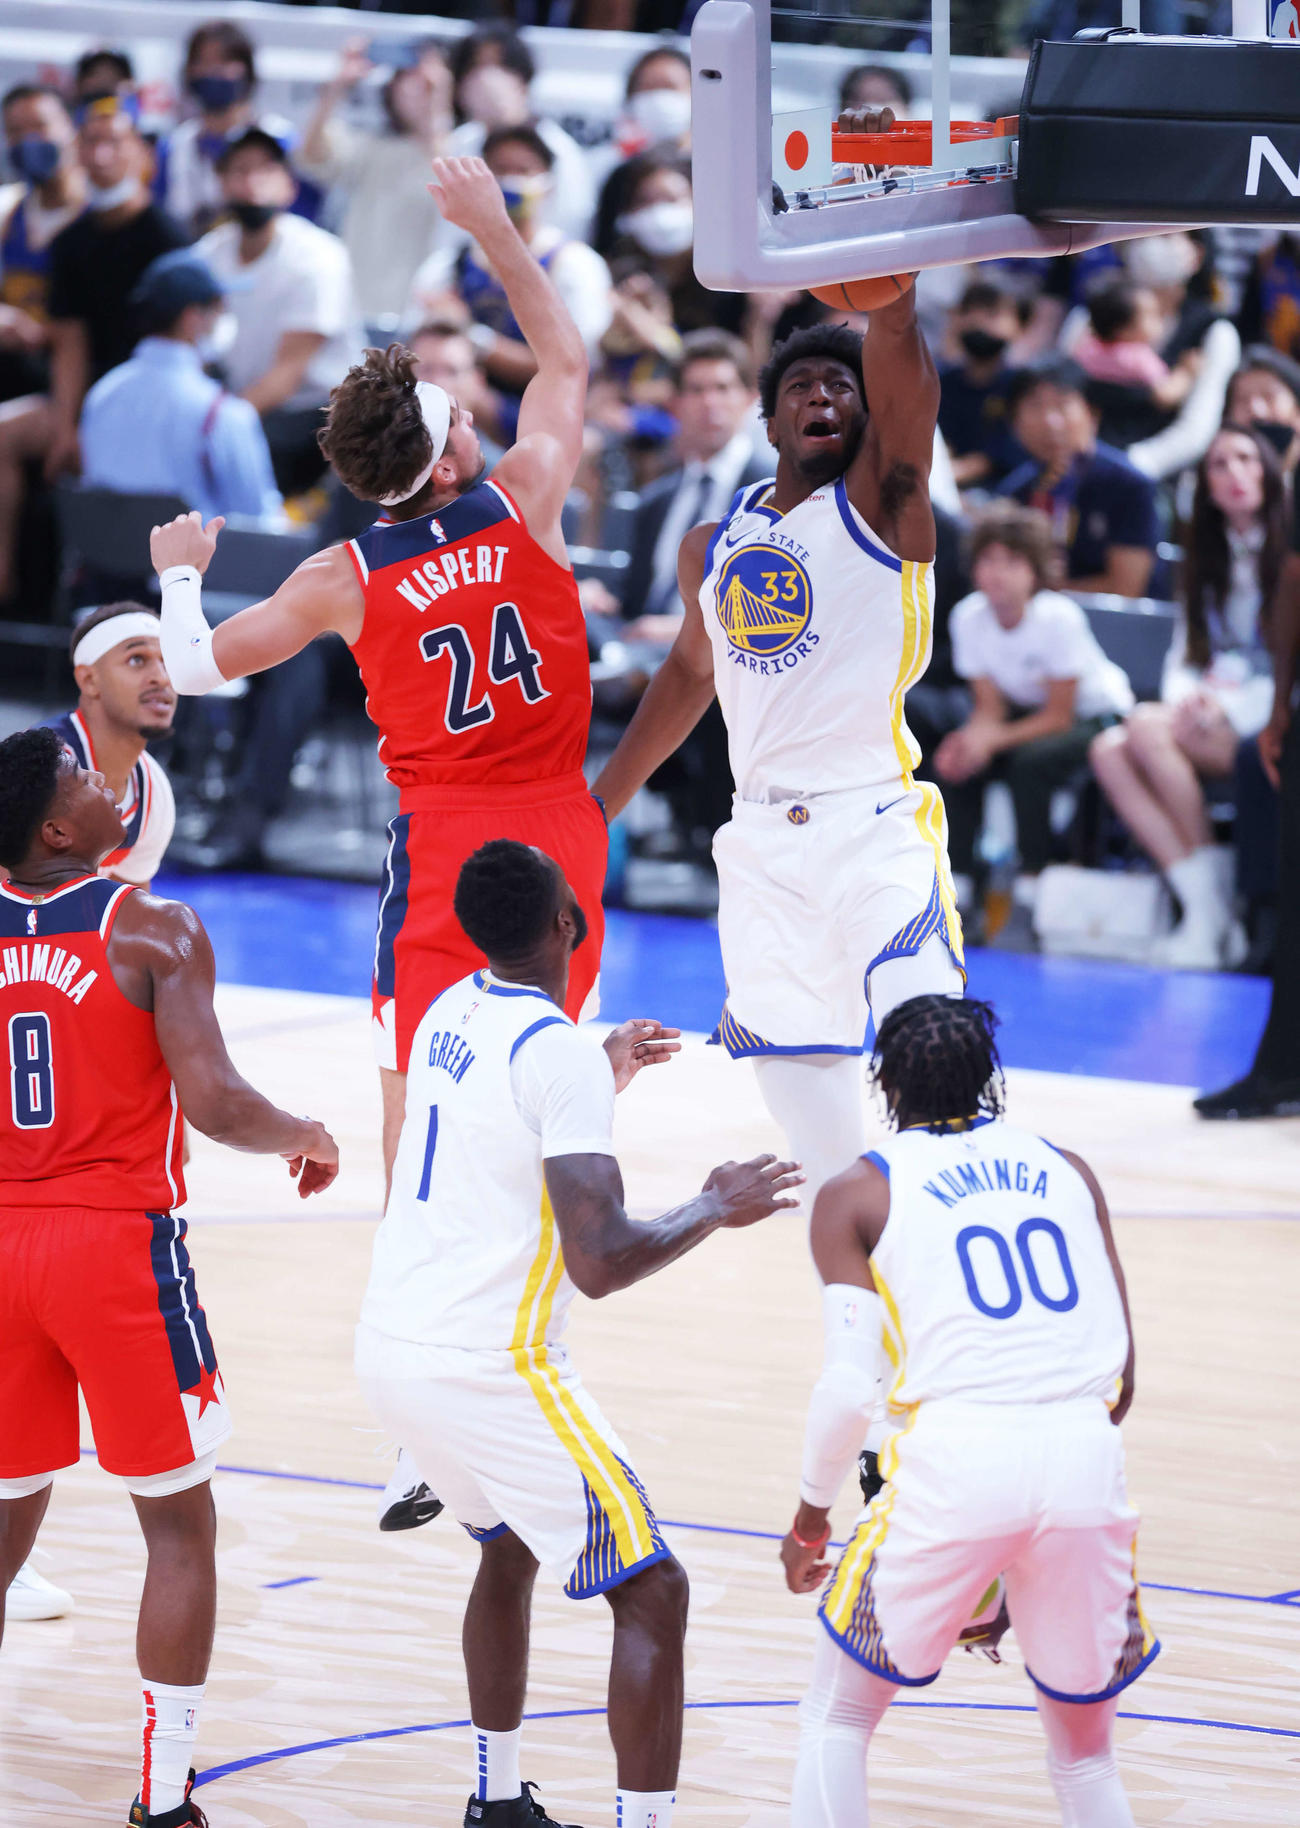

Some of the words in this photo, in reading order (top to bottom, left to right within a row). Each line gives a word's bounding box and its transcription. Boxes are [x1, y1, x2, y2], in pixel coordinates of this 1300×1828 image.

[395, 545, 509, 613] KISPERT
[768, 531, 810, 562] STATE
[760, 571, 799, 602] 33
[418, 601, 552, 735] 24
[8, 1011, 55, 1130] 8
[428, 1031, 476, 1085] GREEN
[416, 1103, 438, 1202] 1
[922, 1159, 1048, 1209] KUMINGA
[956, 1217, 1079, 1320] 00
